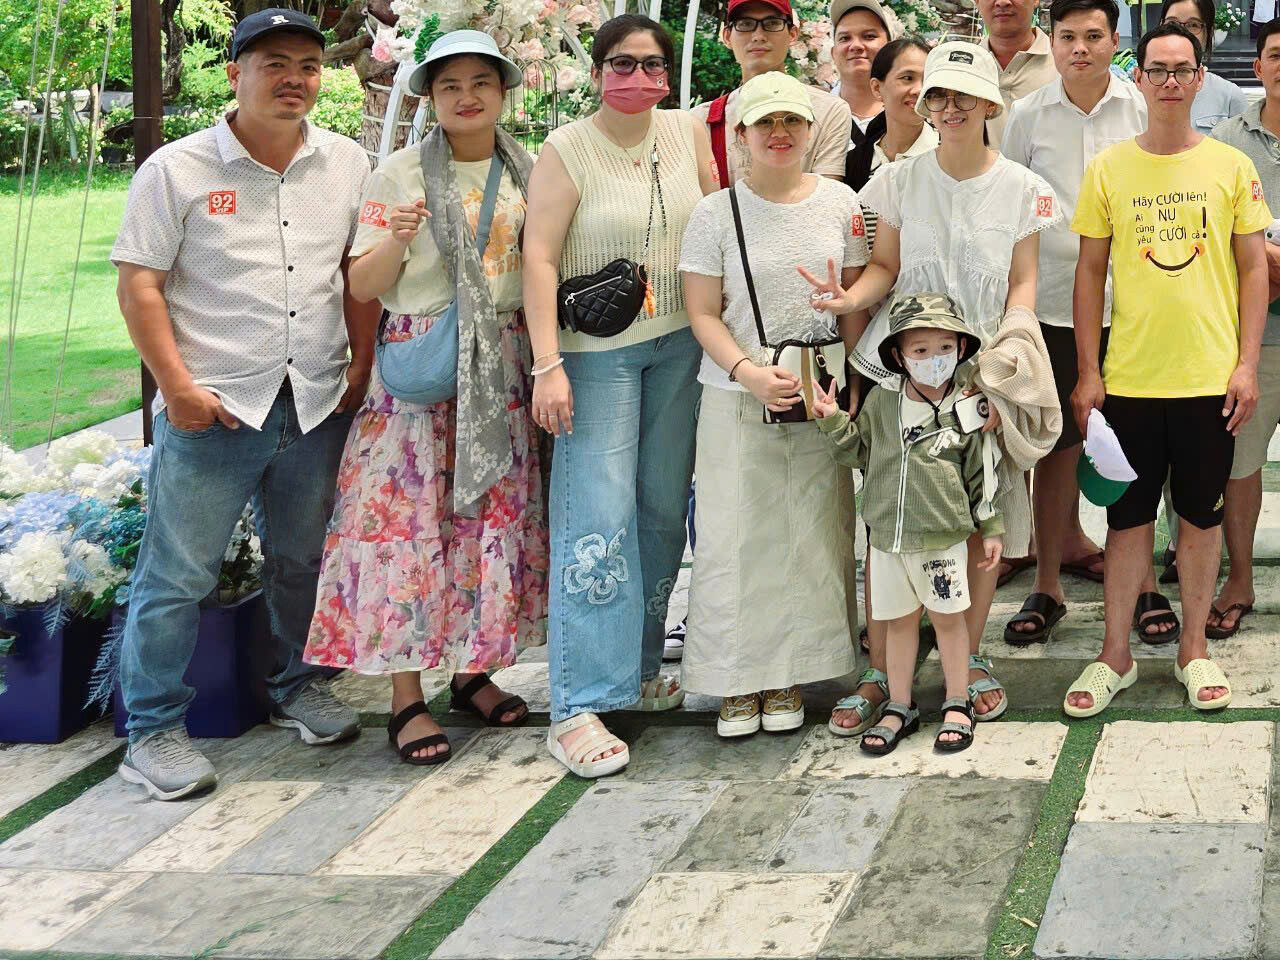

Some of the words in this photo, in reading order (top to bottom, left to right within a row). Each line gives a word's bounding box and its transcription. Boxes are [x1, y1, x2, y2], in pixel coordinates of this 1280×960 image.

[211, 194, 233, 208] 92
[1039, 199, 1051, 211] 92
[1133, 197, 1153, 208] Hãy
[1156, 192, 1184, 206] CƯỜI
[1186, 191, 1207, 202] lên!
[364, 205, 381, 220] 92
[1135, 214, 1144, 222] Ai
[1158, 207, 1176, 224] NỤ
[1135, 225, 1155, 234] cũng
[1159, 225, 1187, 242] CƯỜI
[1137, 235, 1152, 246] yêu
